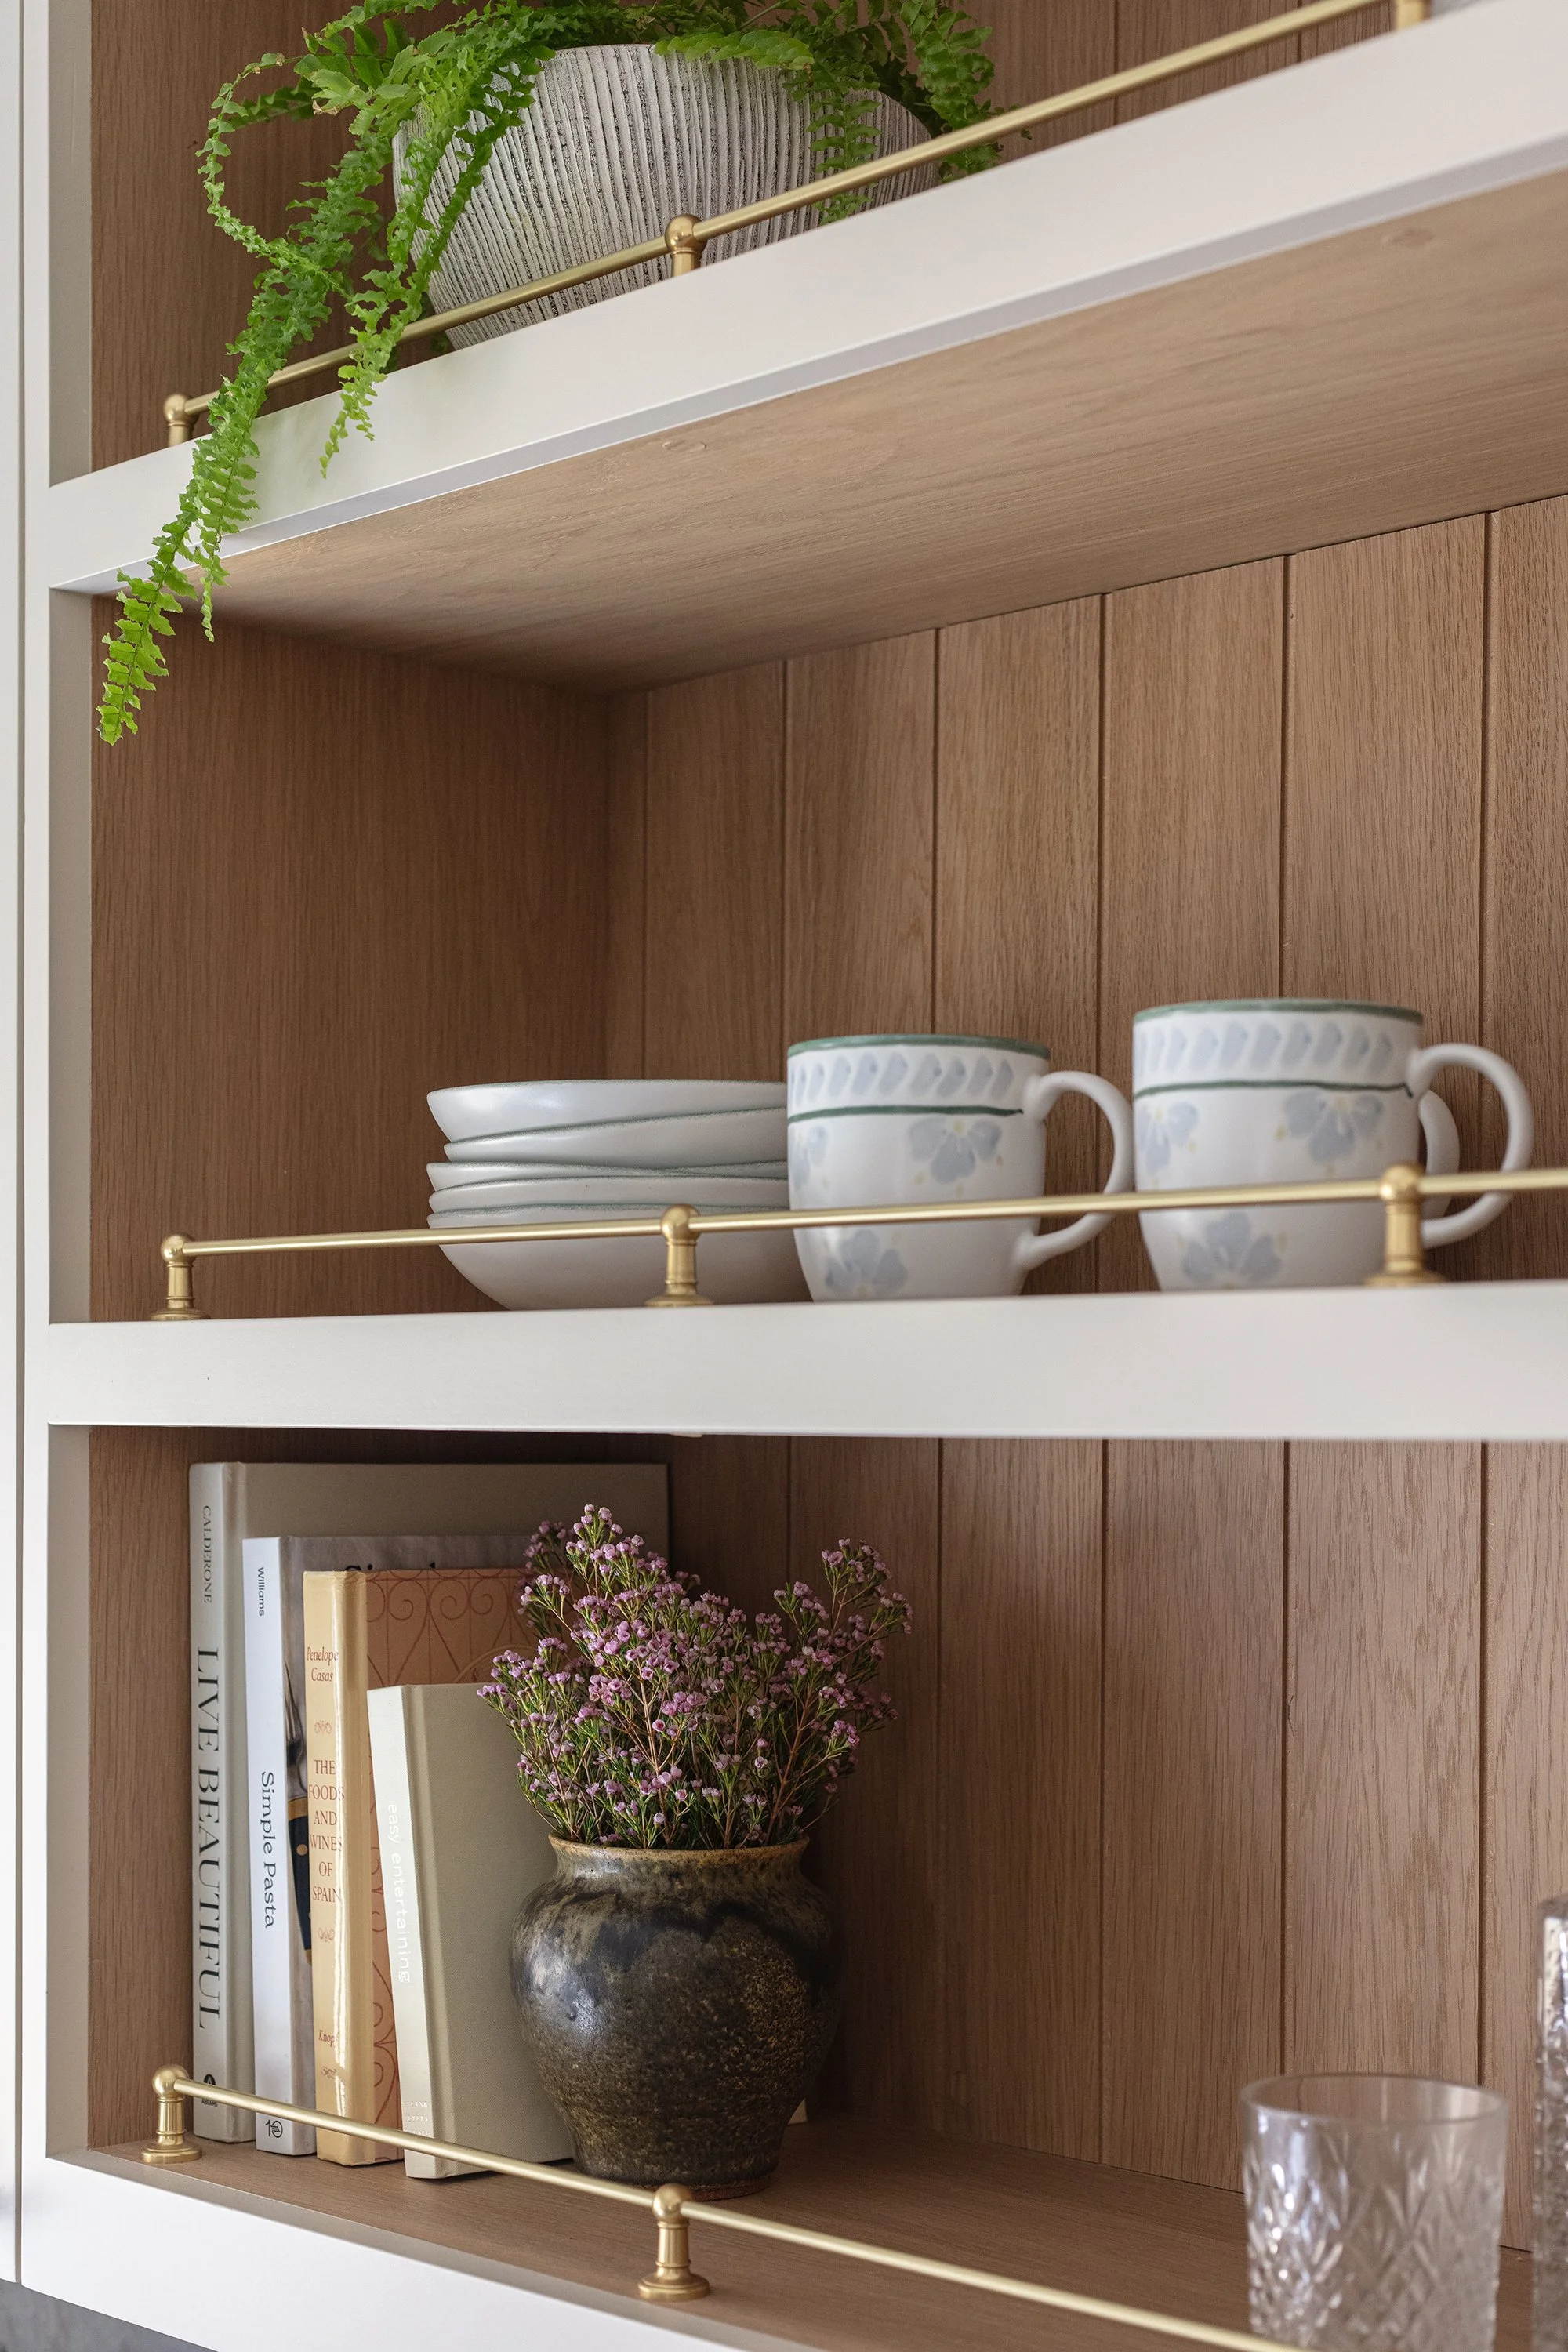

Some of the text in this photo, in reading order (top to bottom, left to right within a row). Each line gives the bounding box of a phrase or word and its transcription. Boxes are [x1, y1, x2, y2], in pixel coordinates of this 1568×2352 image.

[202, 1504, 212, 1604] CALDERONE
[256, 1566, 266, 1617] Williams
[307, 1646, 339, 1666] Penelope
[310, 1667, 334, 1682] Casas
[314, 1759, 336, 1775] THE
[308, 1784, 345, 1801] FOODS
[314, 1809, 338, 1826] AND
[198, 1647, 220, 2030] LIVE BEAUTIFUL
[309, 1833, 343, 1852] WINES
[260, 1771, 277, 1929] Simple Pasta
[318, 1860, 333, 1877] OF
[312, 1886, 343, 1904] SPAIN
[387, 1803, 412, 1983] easy entertaining
